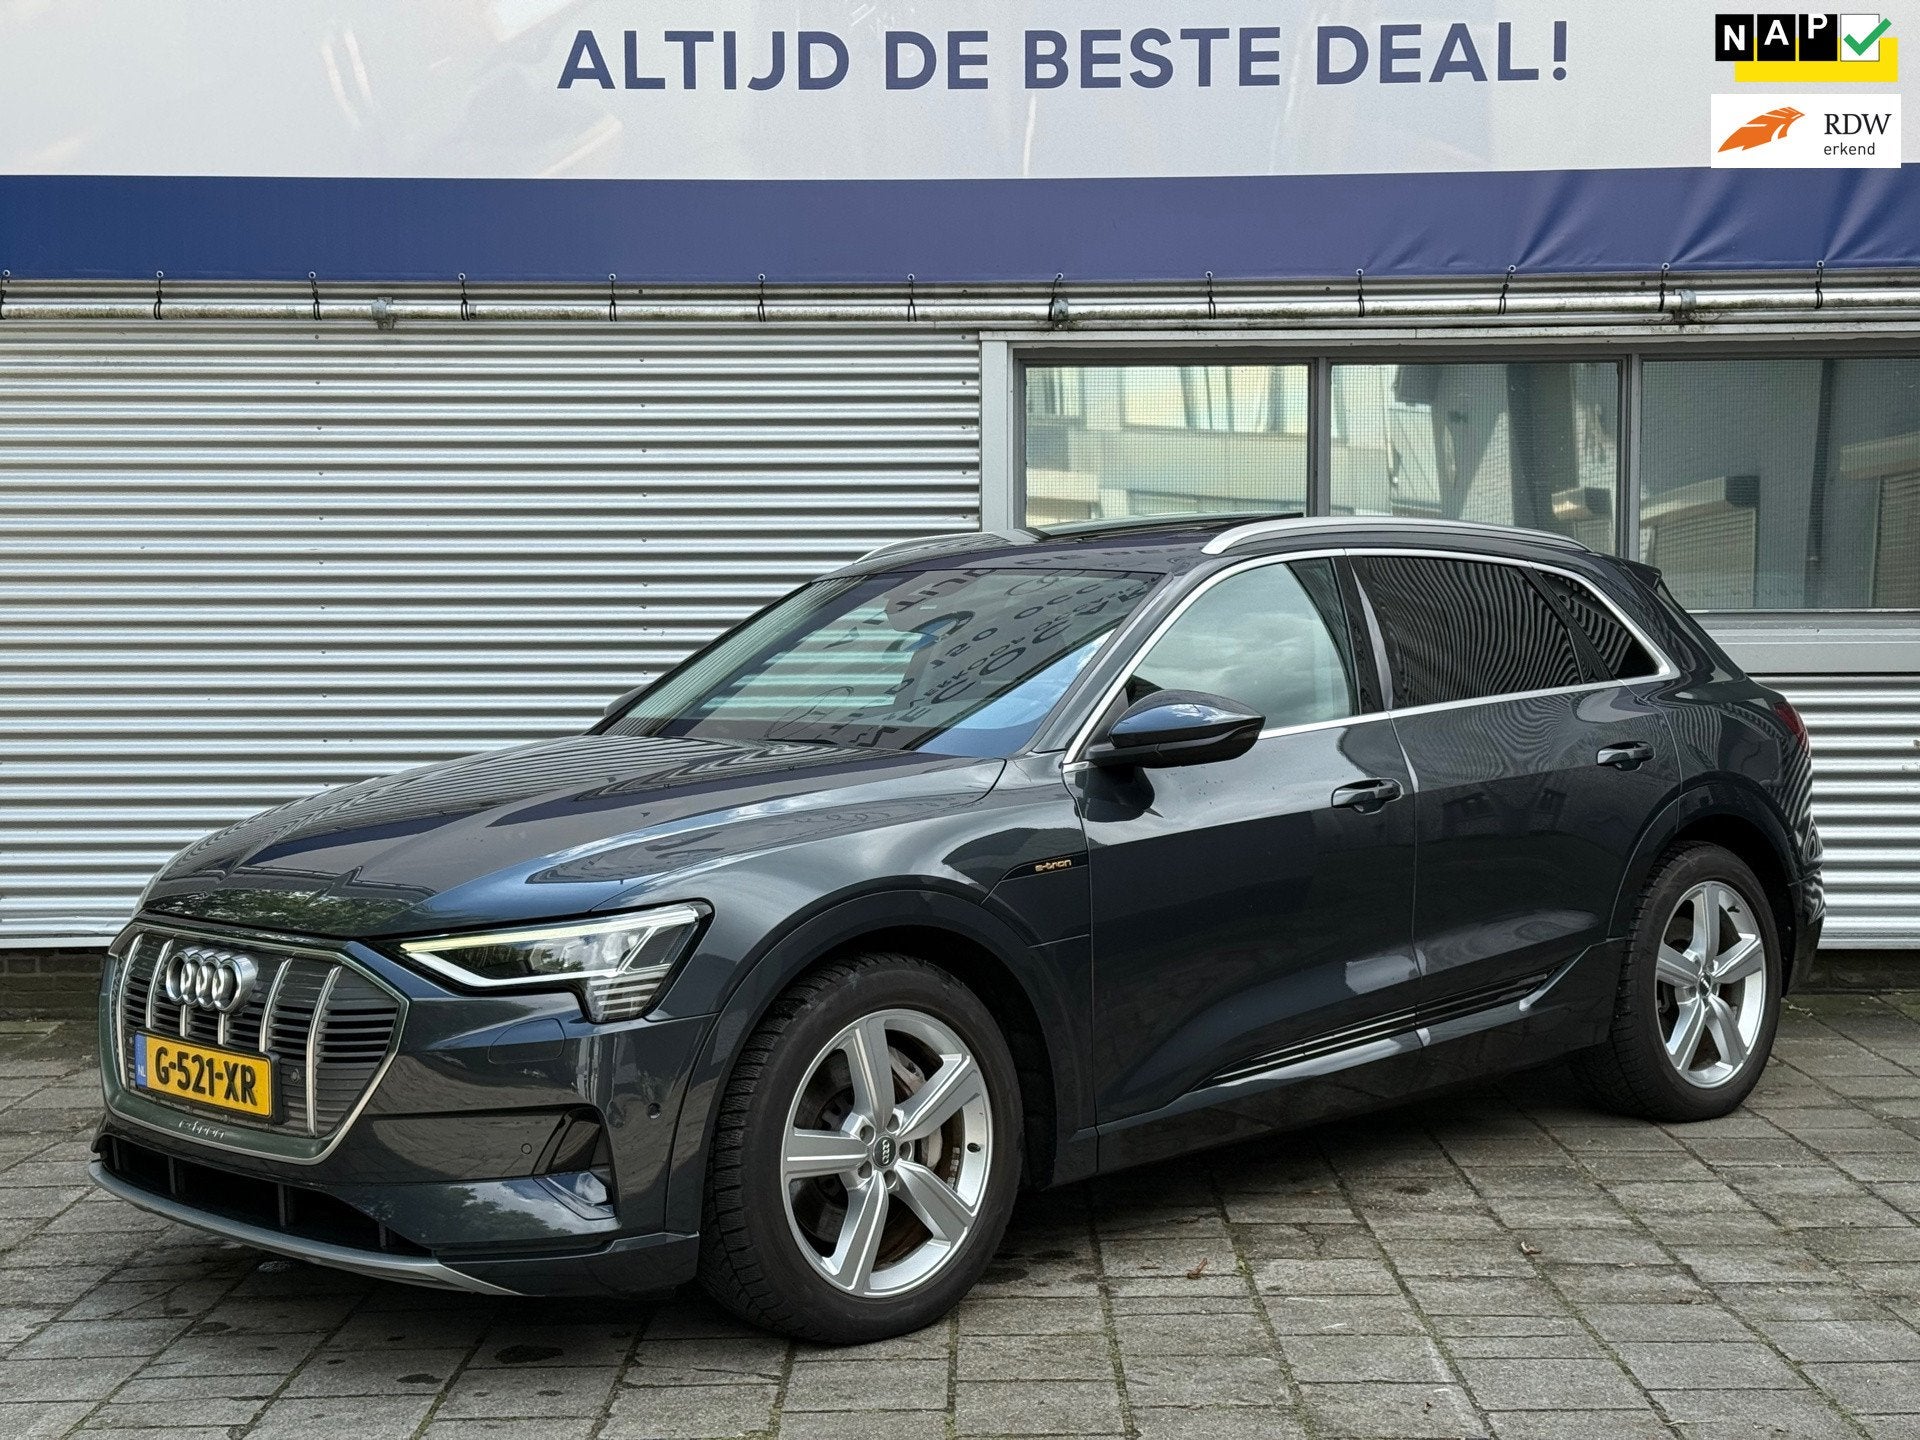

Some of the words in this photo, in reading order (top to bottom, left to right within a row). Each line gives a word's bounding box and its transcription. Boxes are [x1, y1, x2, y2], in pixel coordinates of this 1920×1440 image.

[557, 29, 850, 91] ALTIJD
[885, 30, 989, 90] DE
[1024, 26, 1281, 90] BESTE
[1316, 20, 1568, 86] DEAL!
[1034, 859, 1072, 872] e-tron
[155, 1046, 258, 1107] G-521-XR
